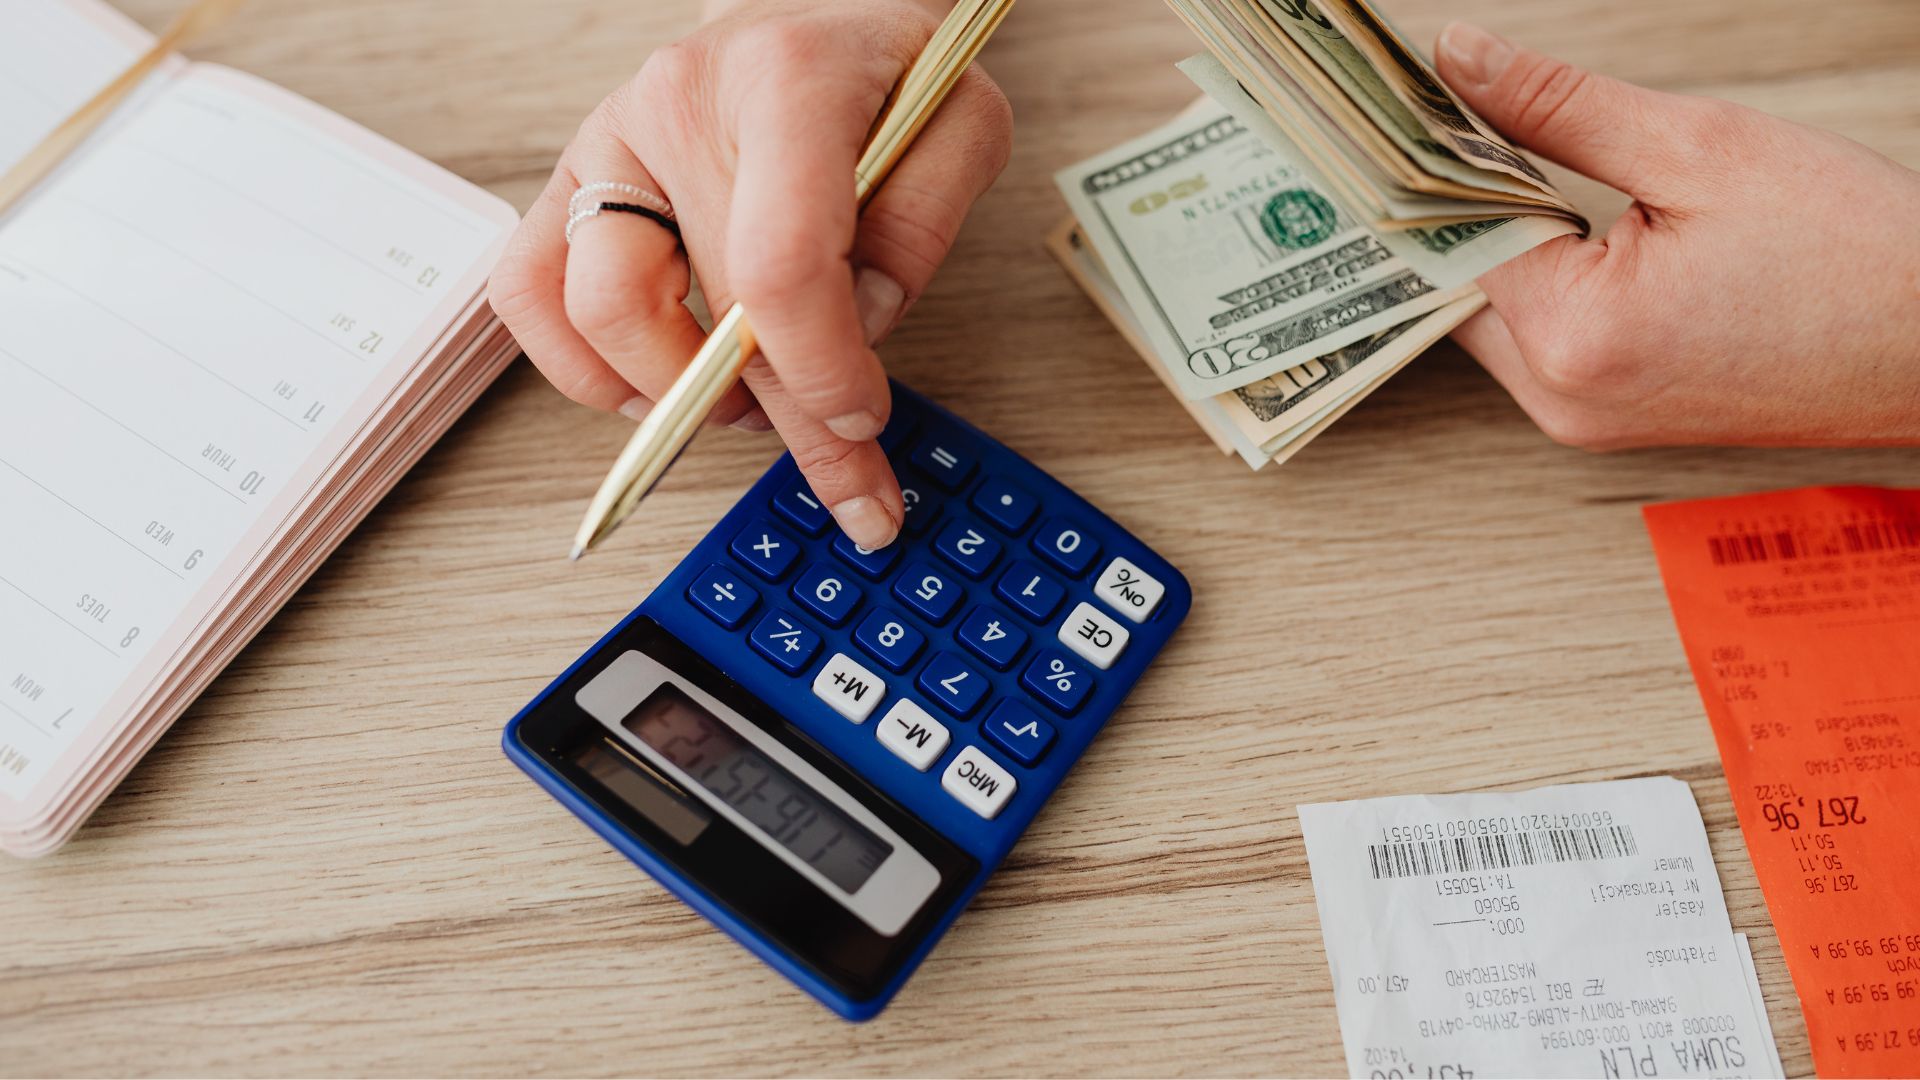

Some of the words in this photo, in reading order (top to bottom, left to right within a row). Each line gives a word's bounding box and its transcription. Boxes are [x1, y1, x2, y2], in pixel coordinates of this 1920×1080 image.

[1130, 174, 1210, 217] 20
[417, 266, 440, 288] 13
[330, 312, 356, 332] SAT
[358, 331, 384, 354] 12
[1188, 333, 1270, 381] 20
[273, 380, 298, 401] FRI
[303, 401, 325, 423] 11
[201, 442, 237, 472] THUR
[239, 471, 266, 495] 10
[145, 521, 175, 547] WED
[957, 529, 985, 555] 2
[1056, 530, 1080, 553] 0
[184, 549, 204, 570] 9
[816, 578, 842, 602] 9
[916, 576, 942, 600] 5
[1022, 576, 1040, 597] 1
[76, 594, 111, 624] TUES
[120, 627, 140, 649] 8
[878, 622, 904, 647] 8
[982, 621, 1006, 642] 4
[1077, 619, 1113, 648] CE
[10, 674, 45, 701] MON
[833, 672, 869, 702] M+
[941, 672, 968, 695] 7
[52, 708, 74, 730] 7
[958, 760, 1000, 798] MRC
[1754, 783, 1797, 801] 13:22
[1762, 796, 1867, 832] 267,96
[1791, 834, 1835, 852] 50,11
[1653, 856, 1694, 872] Numer
[1798, 854, 1842, 873] 50,11
[1436, 873, 1515, 897] TA:150551
[1590, 880, 1674, 903] transakcji
[1685, 879, 1700, 895] Nr
[1804, 875, 1858, 894] 267,96
[1474, 895, 1520, 915] 95060
[1655, 900, 1704, 919] Kasjer
[1646, 946, 1718, 968] Płatność
[1810, 944, 1821, 961] A
[1828, 939, 1873, 960] 99,99
[1358, 974, 1409, 994] 457,00
[1445, 962, 1536, 987] MASTERCARD
[1465, 986, 1536, 1010] 15492676
[1545, 982, 1573, 1001] BGI
[1825, 989, 1836, 1006] A
[1843, 983, 1890, 1004] 59,99
[1540, 1025, 1630, 1050] 000:601994
[1640, 1021, 1673, 1040] #001
[1671, 1036, 1745, 1073] SUMA
[1836, 1036, 1847, 1053] A
[1363, 1047, 1407, 1066] 14:02
[1600, 1045, 1657, 1080] PLN
